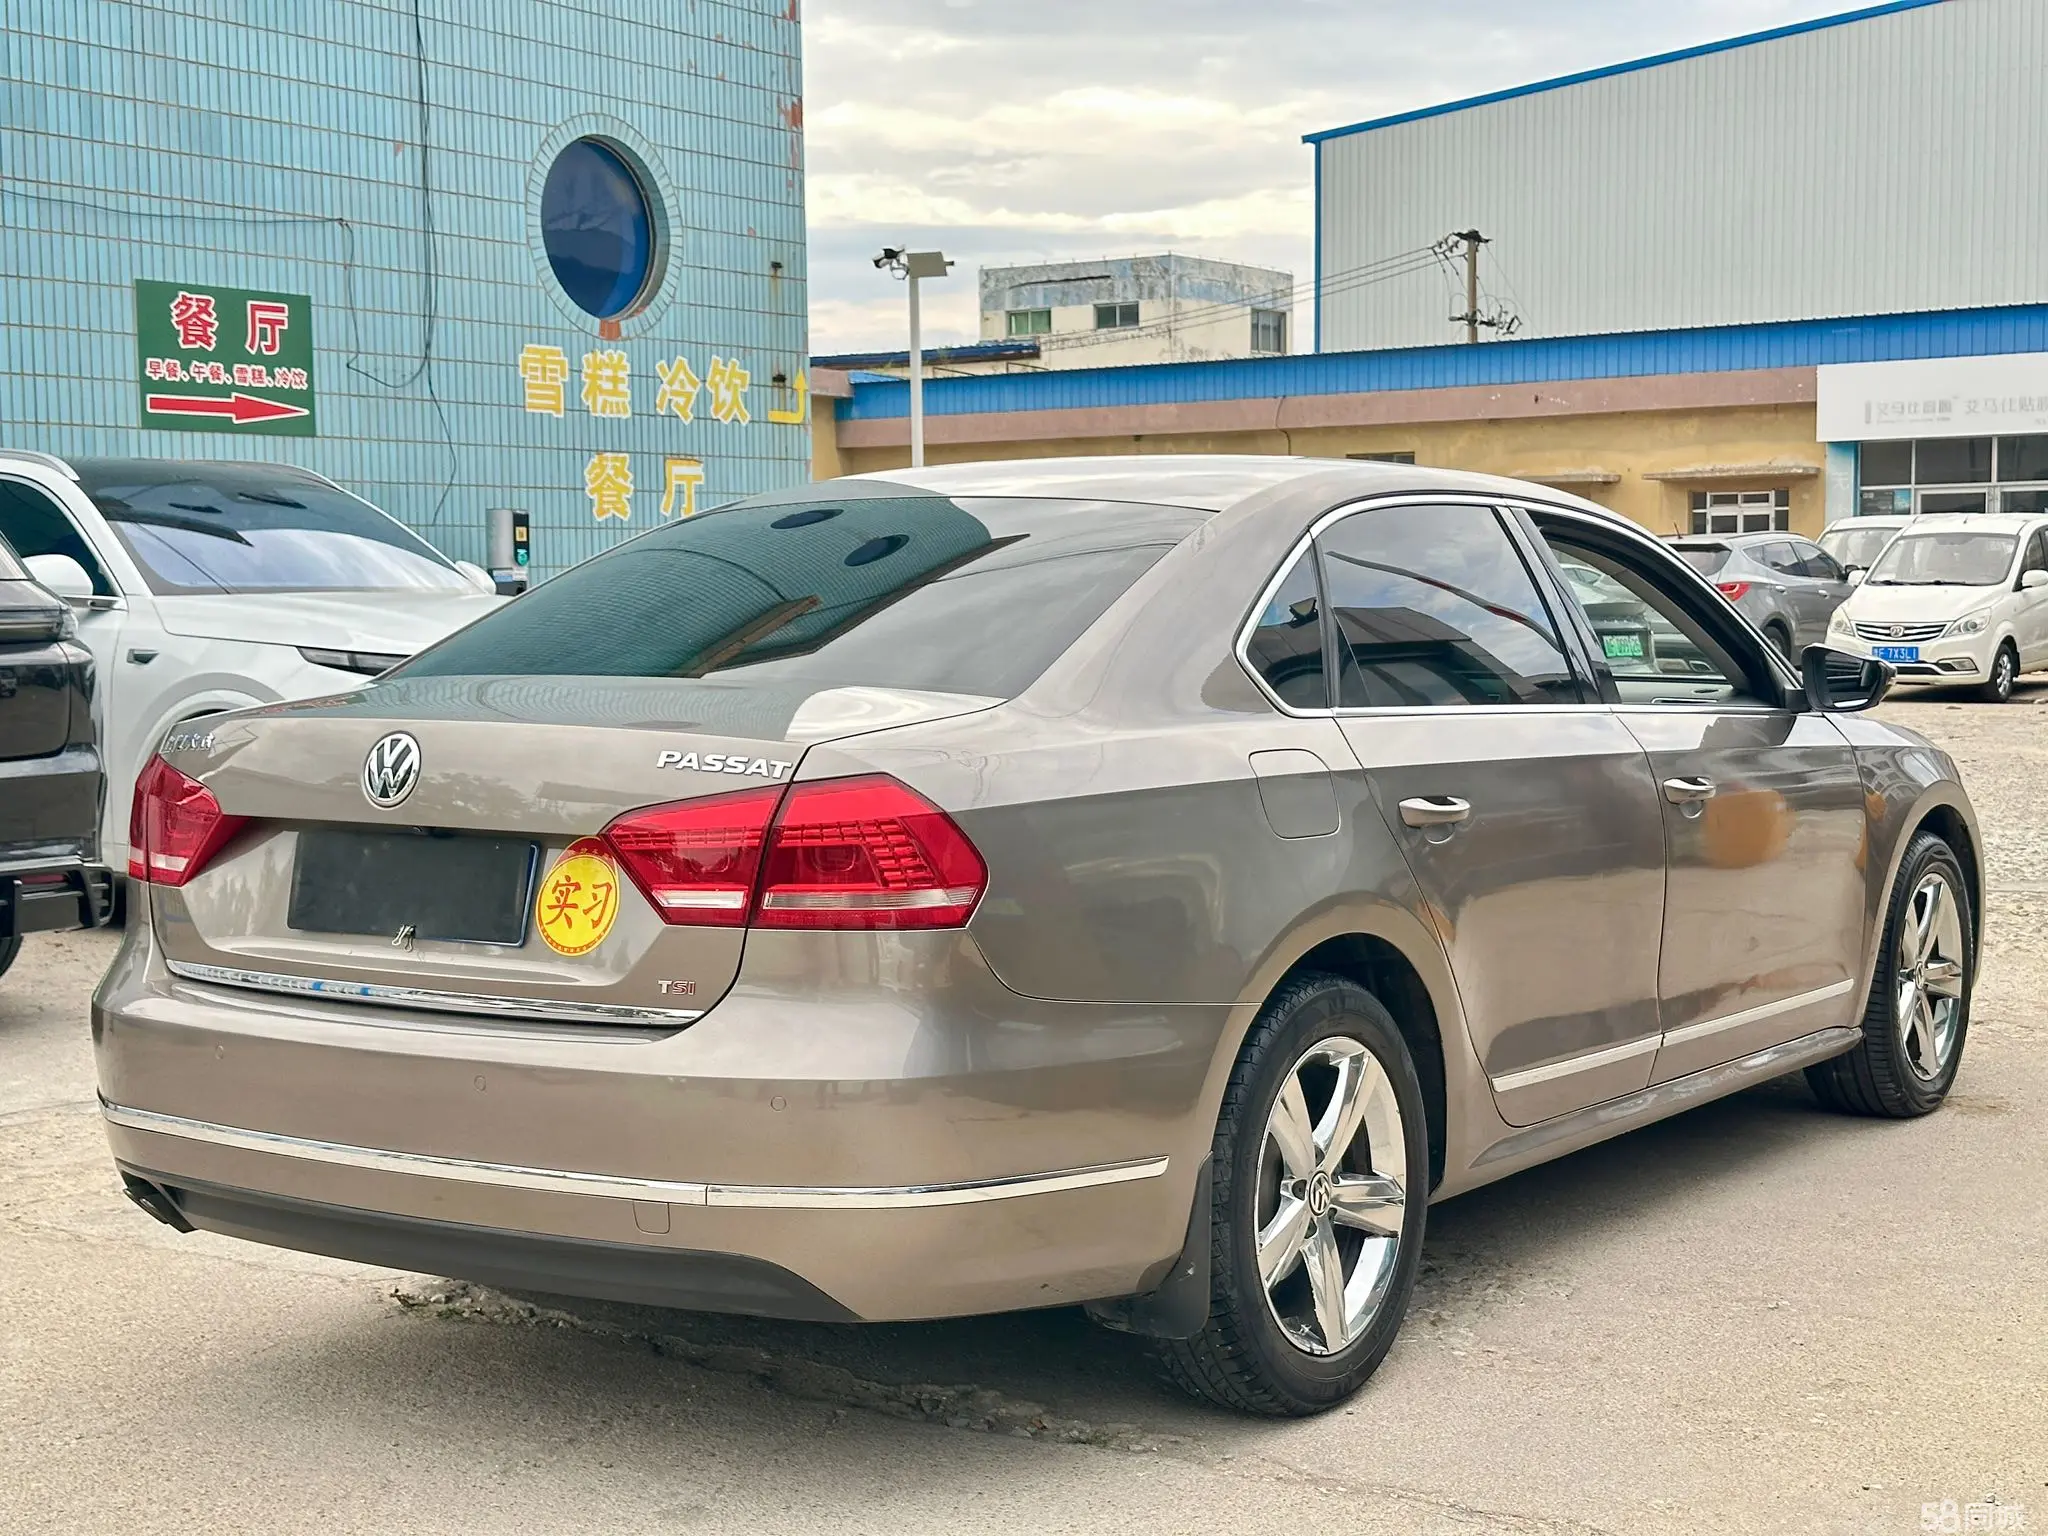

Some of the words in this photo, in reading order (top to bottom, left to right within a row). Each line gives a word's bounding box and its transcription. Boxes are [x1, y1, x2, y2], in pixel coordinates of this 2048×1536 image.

[170, 291, 288, 355] 餐厅
[519, 344, 631, 419] 雪糕
[655, 354, 751, 425] 冷饮
[584, 453, 704, 521] 餐厅
[656, 750, 792, 779] PASSAT
[545, 875, 613, 929] 实习
[658, 979, 696, 995] TSI
